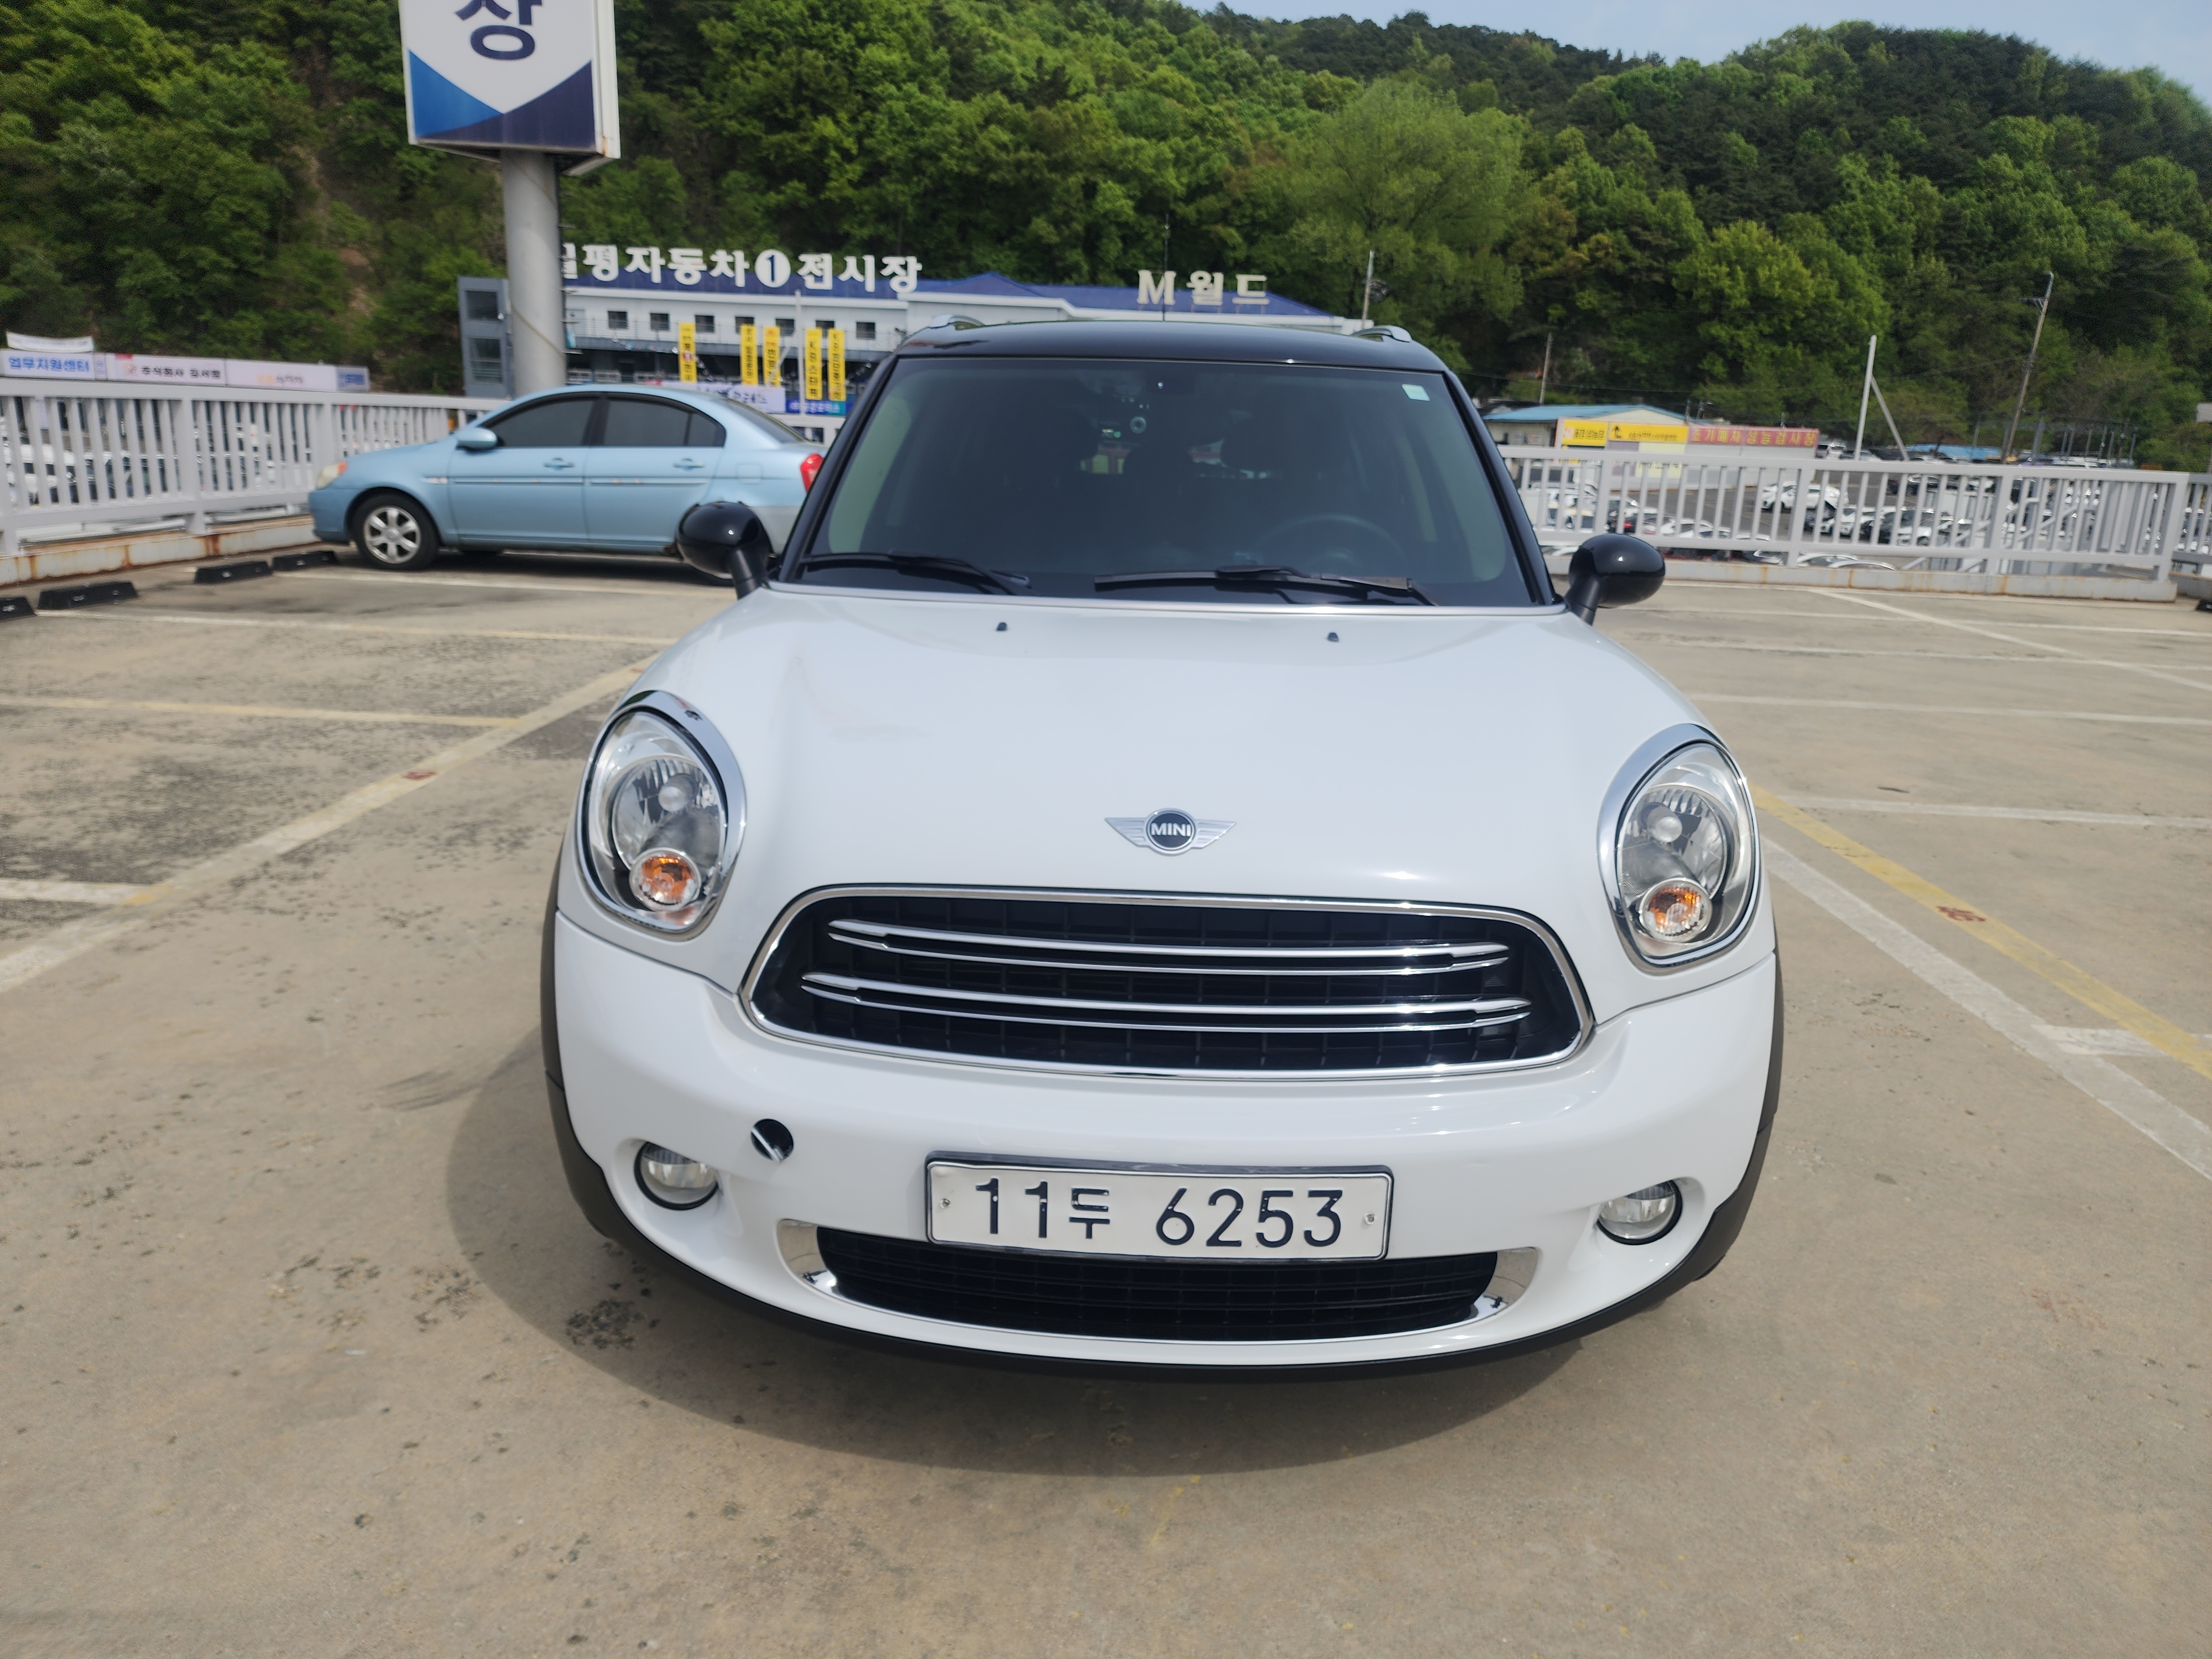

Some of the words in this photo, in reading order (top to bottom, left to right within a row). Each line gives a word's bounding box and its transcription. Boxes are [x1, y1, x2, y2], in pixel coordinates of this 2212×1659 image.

[9, 357, 90, 373] 업무지원센터
[1150, 822, 1192, 837] MINI
[975, 1177, 1110, 1239] 11두
[1156, 1187, 1344, 1248] 6253
